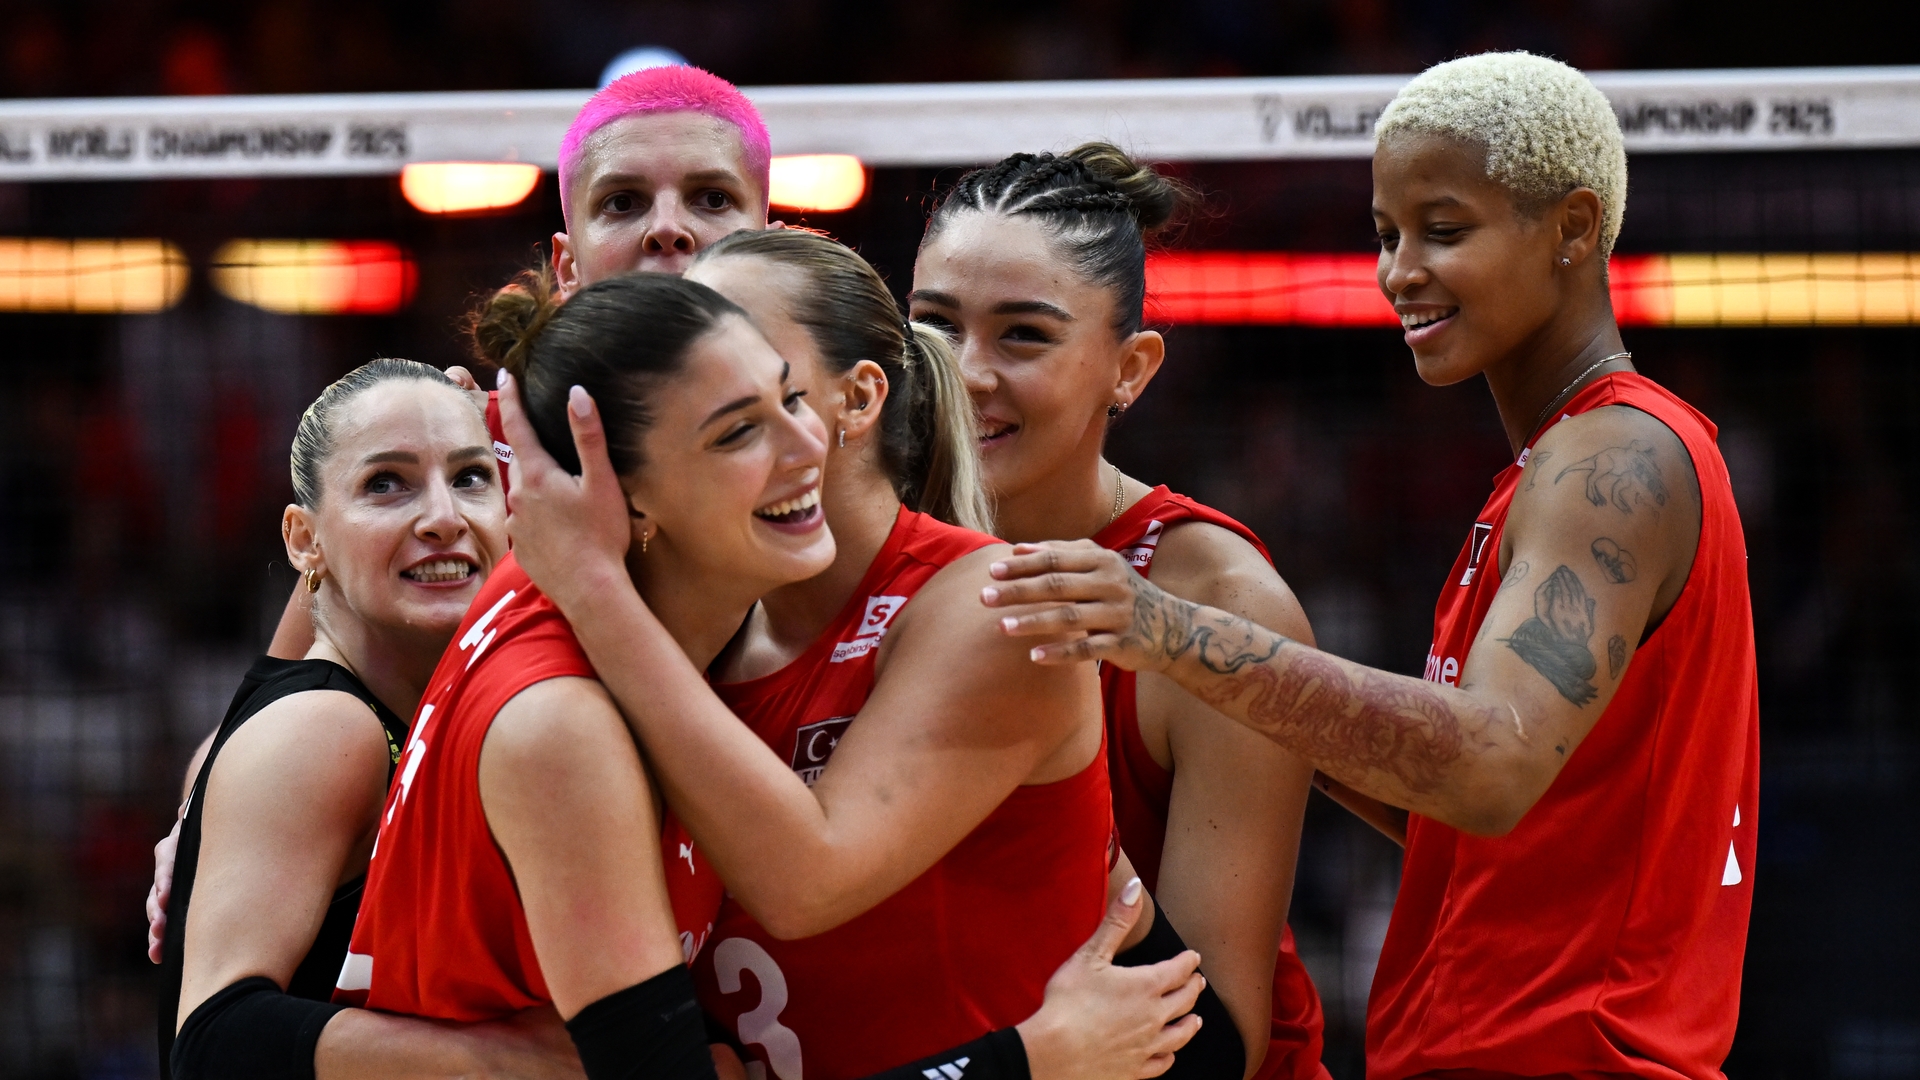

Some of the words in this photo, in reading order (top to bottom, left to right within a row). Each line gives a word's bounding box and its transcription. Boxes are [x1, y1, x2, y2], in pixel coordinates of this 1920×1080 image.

[1769, 101, 1833, 134] 2025
[49, 127, 133, 160] WORLD
[148, 124, 332, 160] CHAMPIONSHIP
[345, 122, 409, 156] 2025
[867, 603, 891, 627] S
[713, 937, 803, 1080] 3
